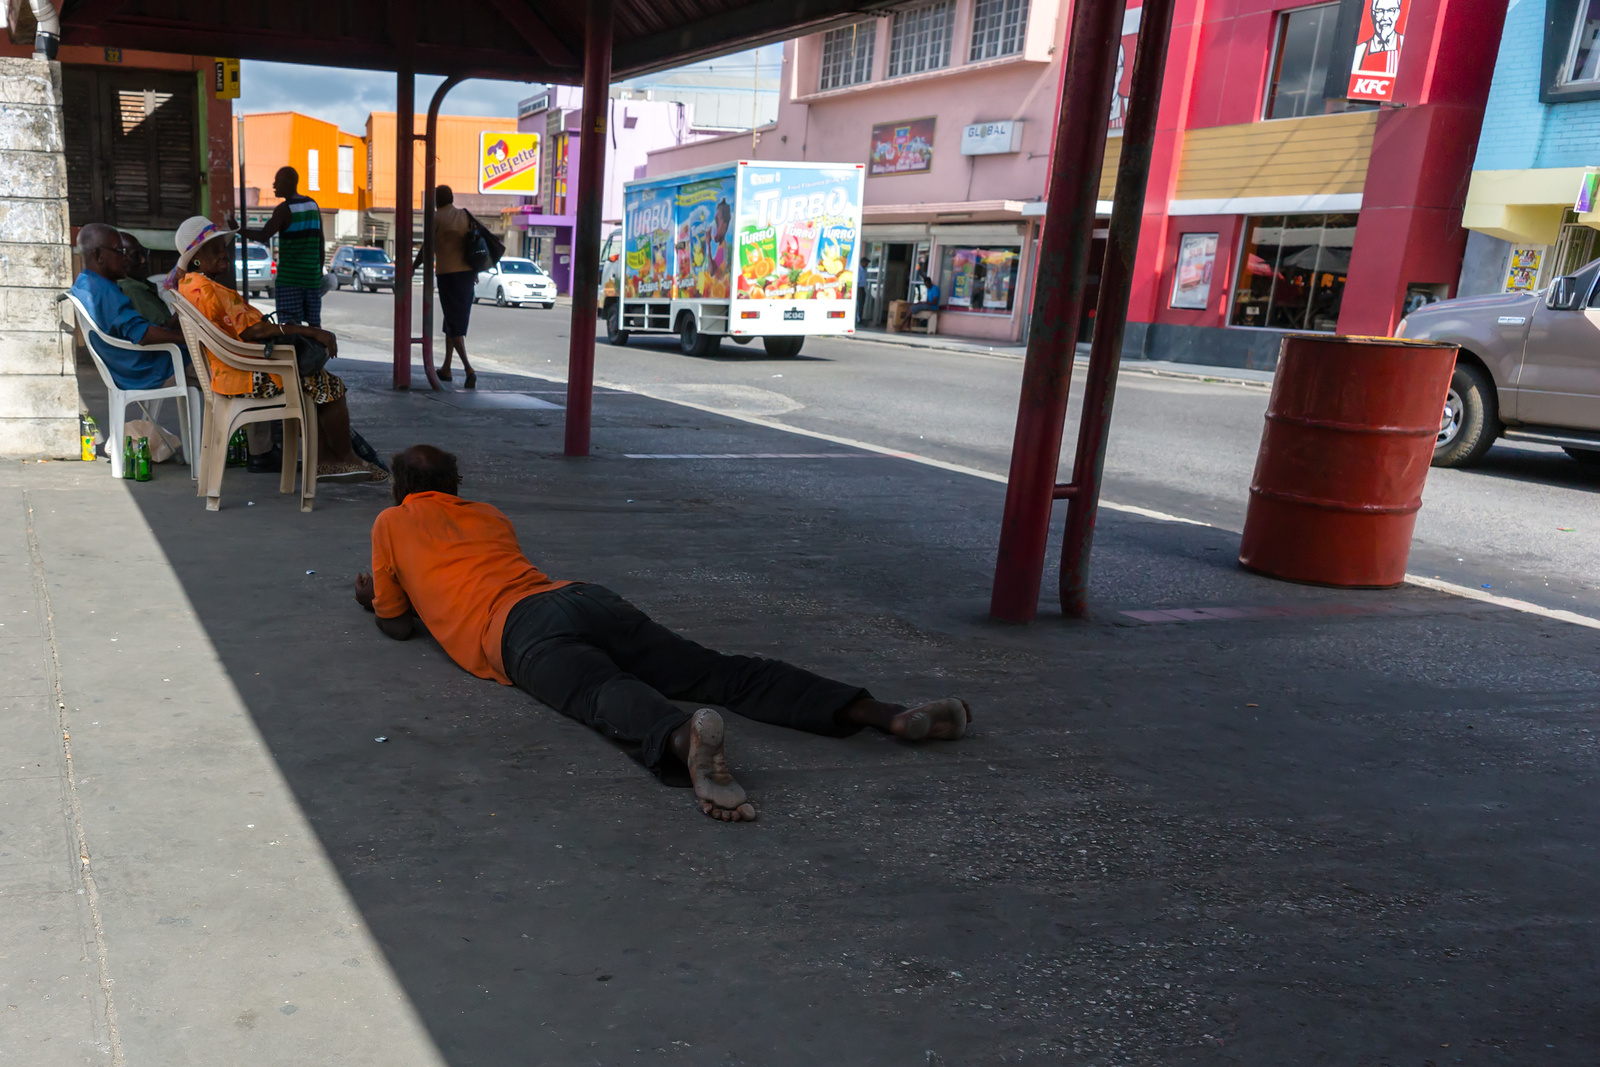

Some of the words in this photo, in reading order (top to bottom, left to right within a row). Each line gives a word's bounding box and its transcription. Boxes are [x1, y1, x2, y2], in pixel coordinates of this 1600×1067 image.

[107, 50, 119, 62] 32
[1353, 78, 1390, 95] KFC
[484, 148, 536, 179] Chefette
[753, 187, 848, 229] TURBO
[627, 199, 672, 240] TURBO
[740, 227, 775, 245] TURBO
[822, 225, 855, 240] TURBO
